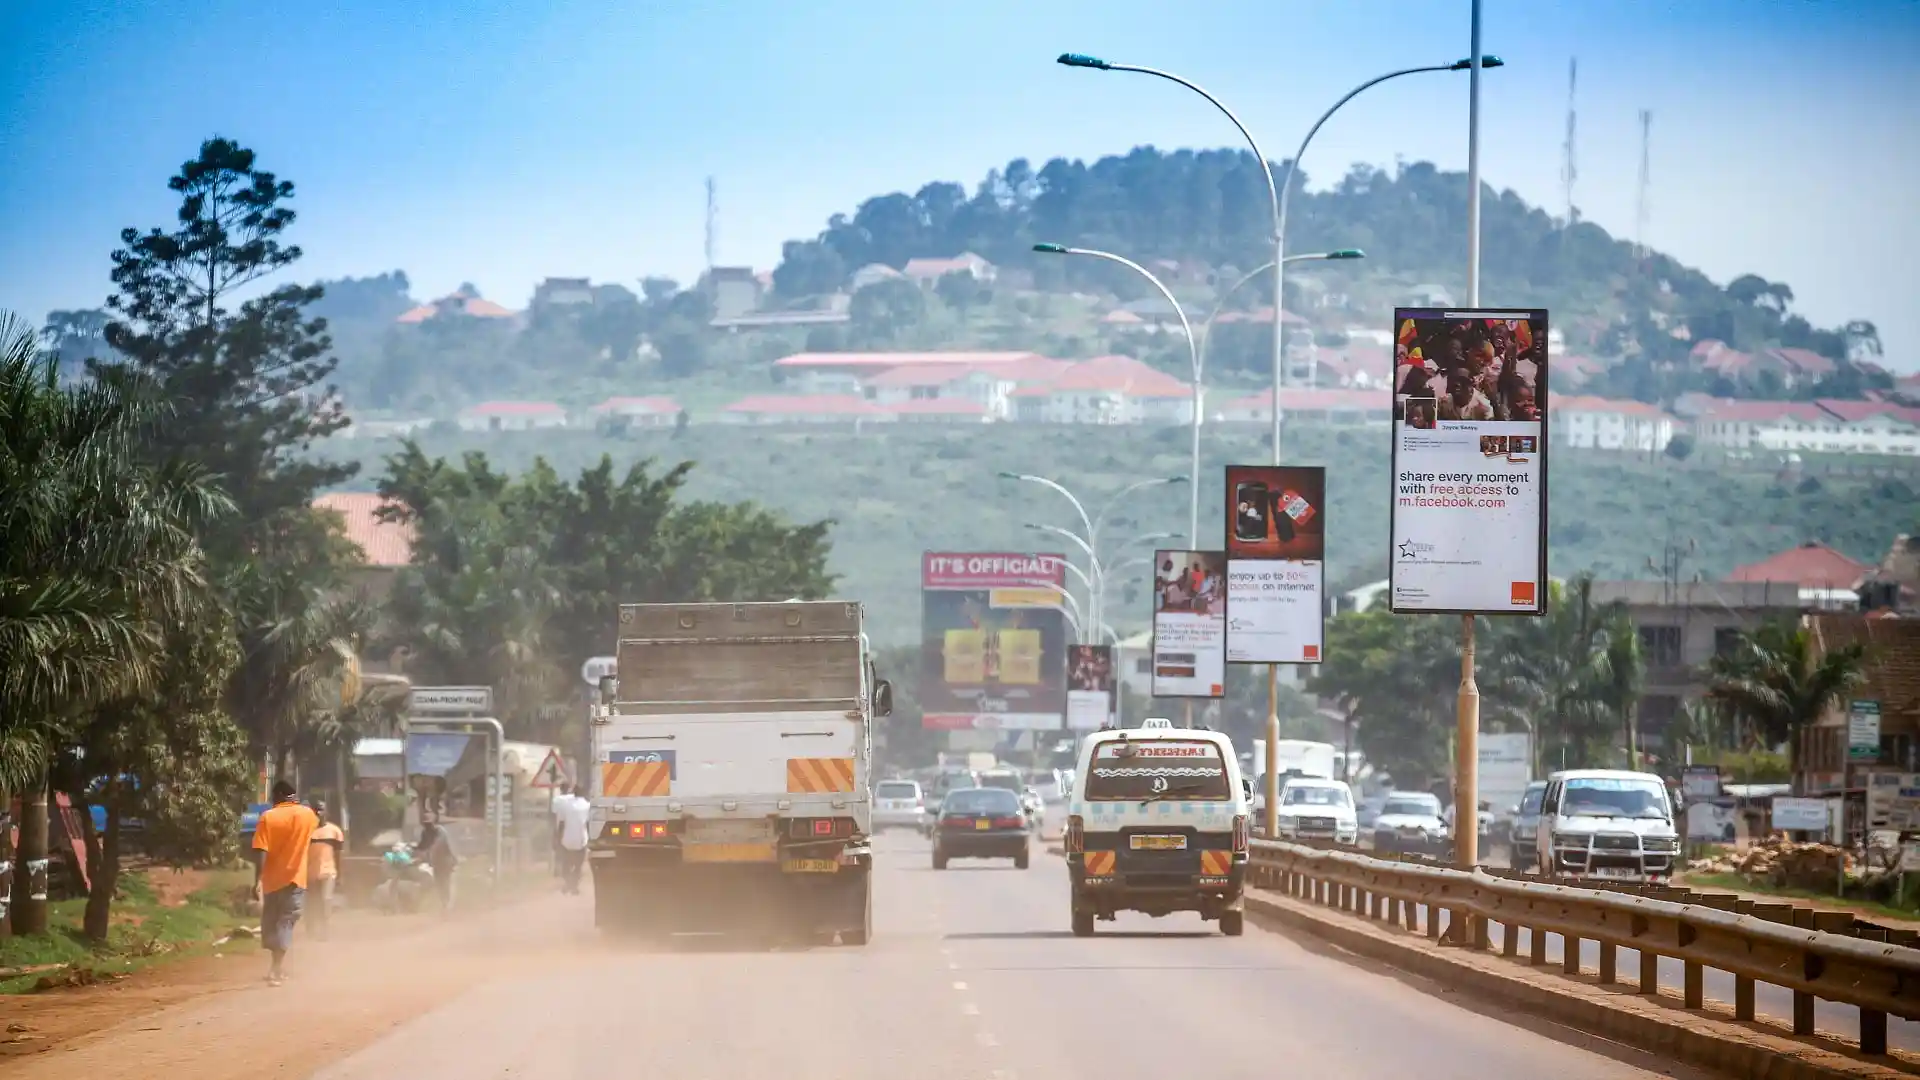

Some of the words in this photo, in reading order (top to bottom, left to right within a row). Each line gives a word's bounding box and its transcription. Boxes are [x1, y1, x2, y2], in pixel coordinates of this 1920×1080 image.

[1400, 471, 1434, 482] share
[1438, 472, 1473, 484] every
[1477, 472, 1529, 483] moment
[1400, 483, 1426, 494] with
[1430, 484, 1454, 495] free
[1458, 485, 1502, 495] access
[1506, 485, 1519, 496] to
[1399, 496, 1506, 507] m.facebook.com
[930, 558, 964, 574] IT'S
[1273, 572, 1284, 580] to
[1147, 720, 1168, 729] TAXI
